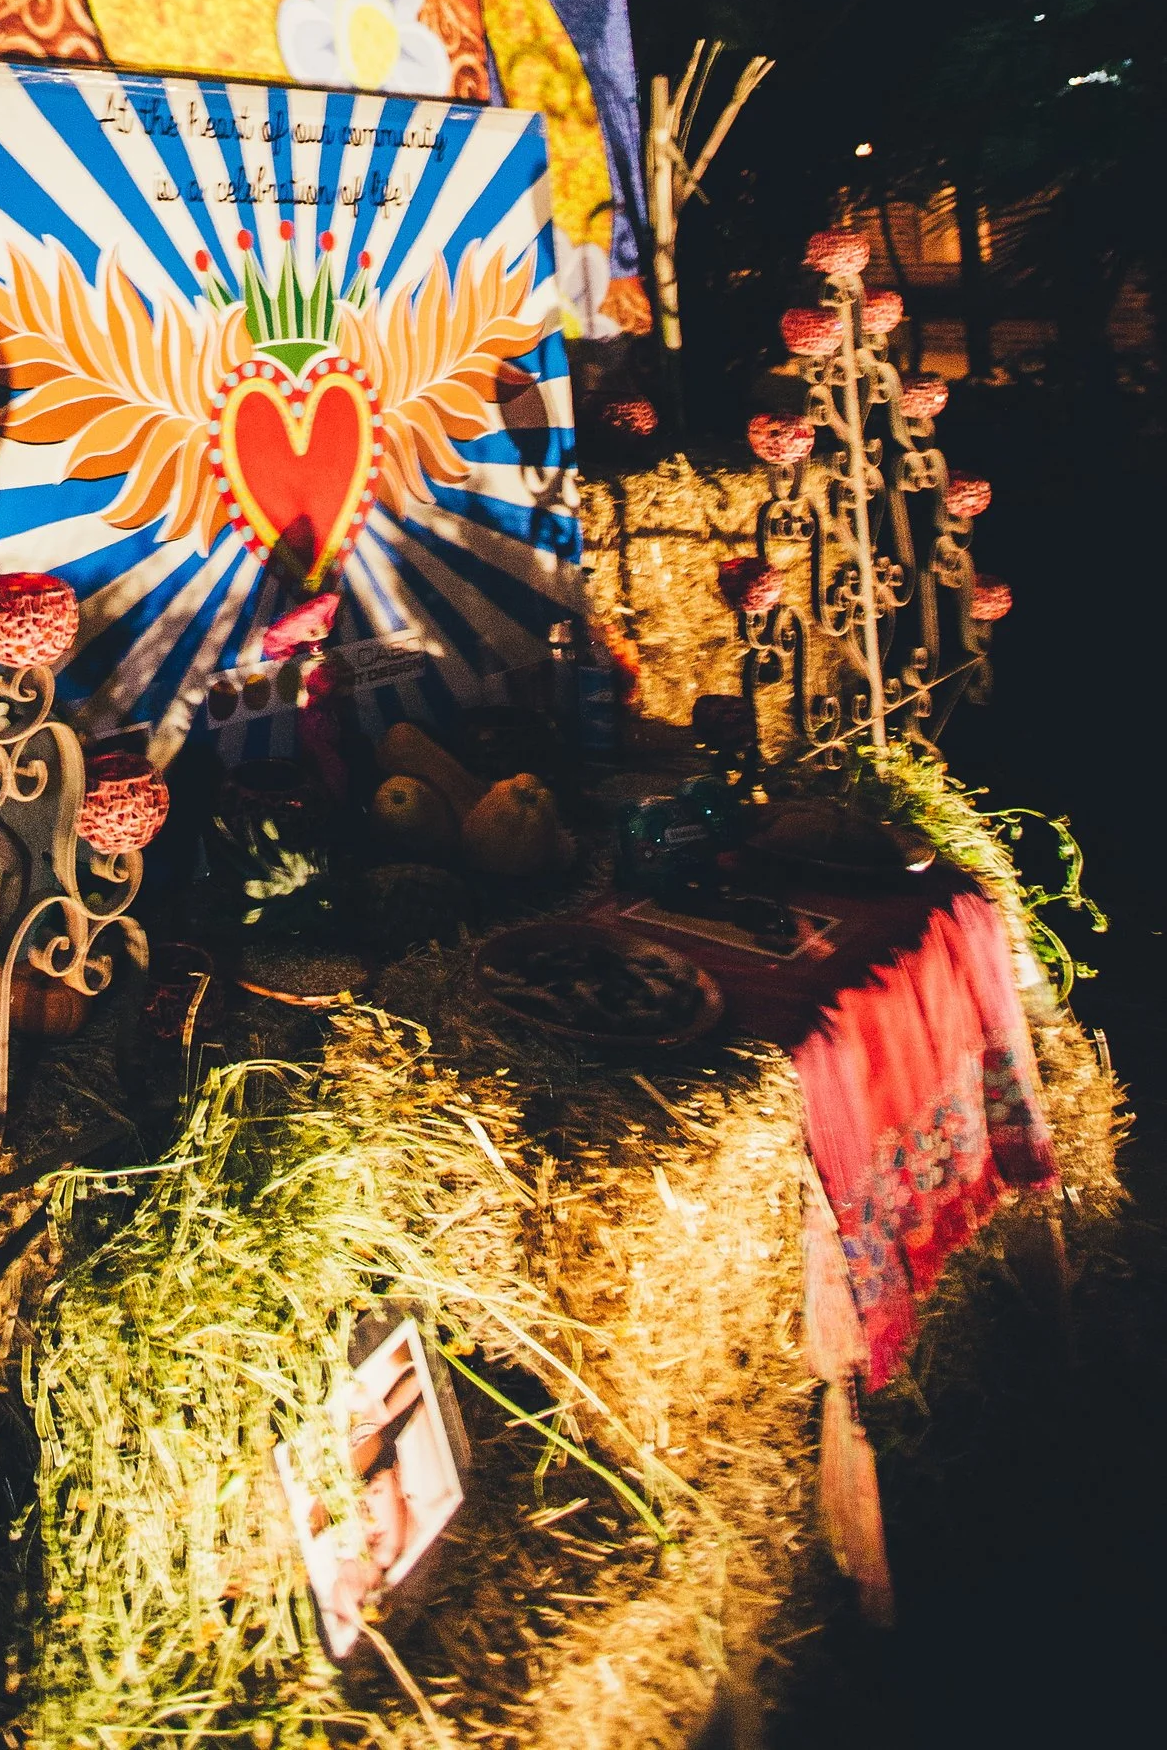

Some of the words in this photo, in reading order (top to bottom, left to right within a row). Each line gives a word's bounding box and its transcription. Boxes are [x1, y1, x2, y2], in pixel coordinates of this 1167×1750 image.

[97, 92, 133, 134] At
[135, 98, 179, 137] the
[187, 101, 255, 141] heart
[261, 110, 290, 156] of
[295, 123, 336, 144] our
[341, 118, 448, 163] community
[153, 172, 181, 201] is
[189, 179, 205, 201] a
[216, 165, 337, 205] celebration
[341, 176, 363, 218] of
